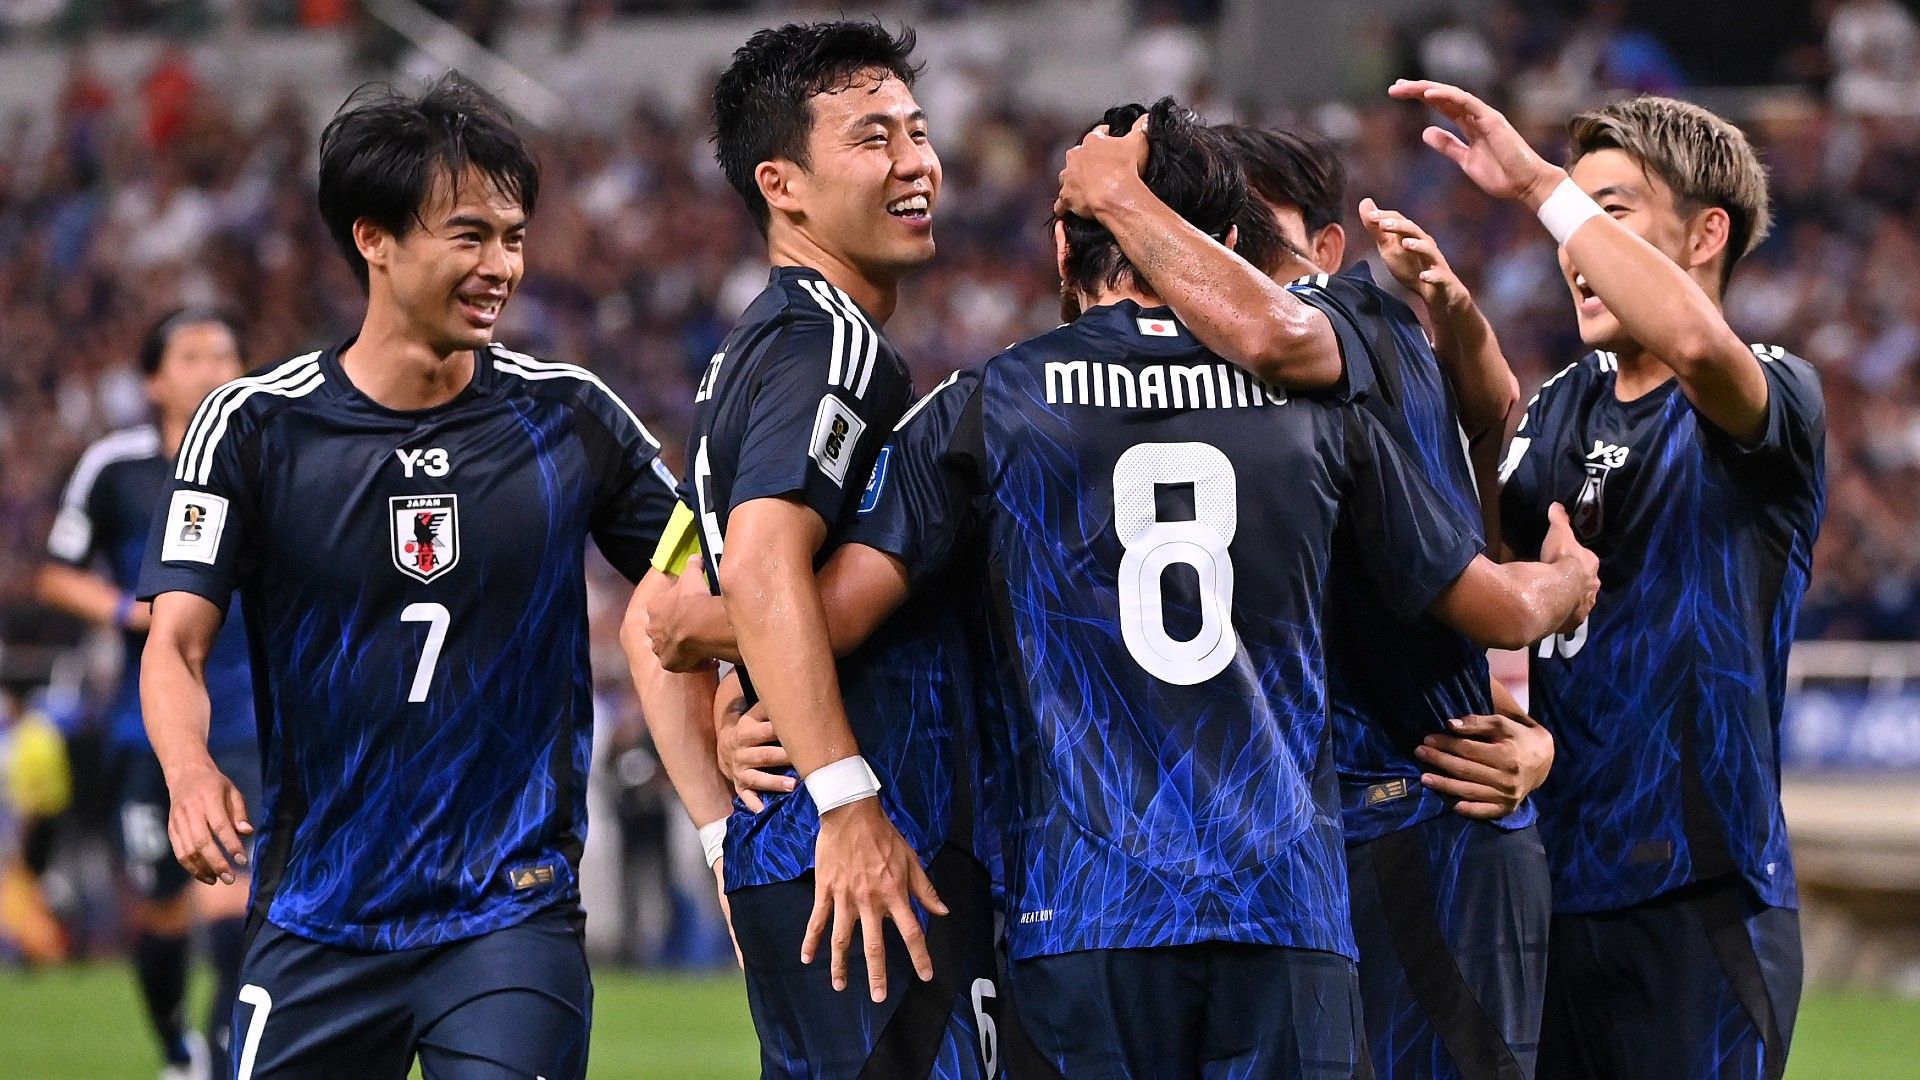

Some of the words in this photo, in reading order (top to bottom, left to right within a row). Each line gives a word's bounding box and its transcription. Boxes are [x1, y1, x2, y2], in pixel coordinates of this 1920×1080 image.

[396, 448, 450, 478] Y-3
[1586, 440, 1630, 468] Y-3
[406, 498, 441, 508] JAPAN
[412, 553, 440, 567] JFA
[1113, 442, 1237, 685] 8
[400, 602, 451, 703] 7
[238, 983, 272, 1080] 7
[971, 978, 997, 1080] 6
